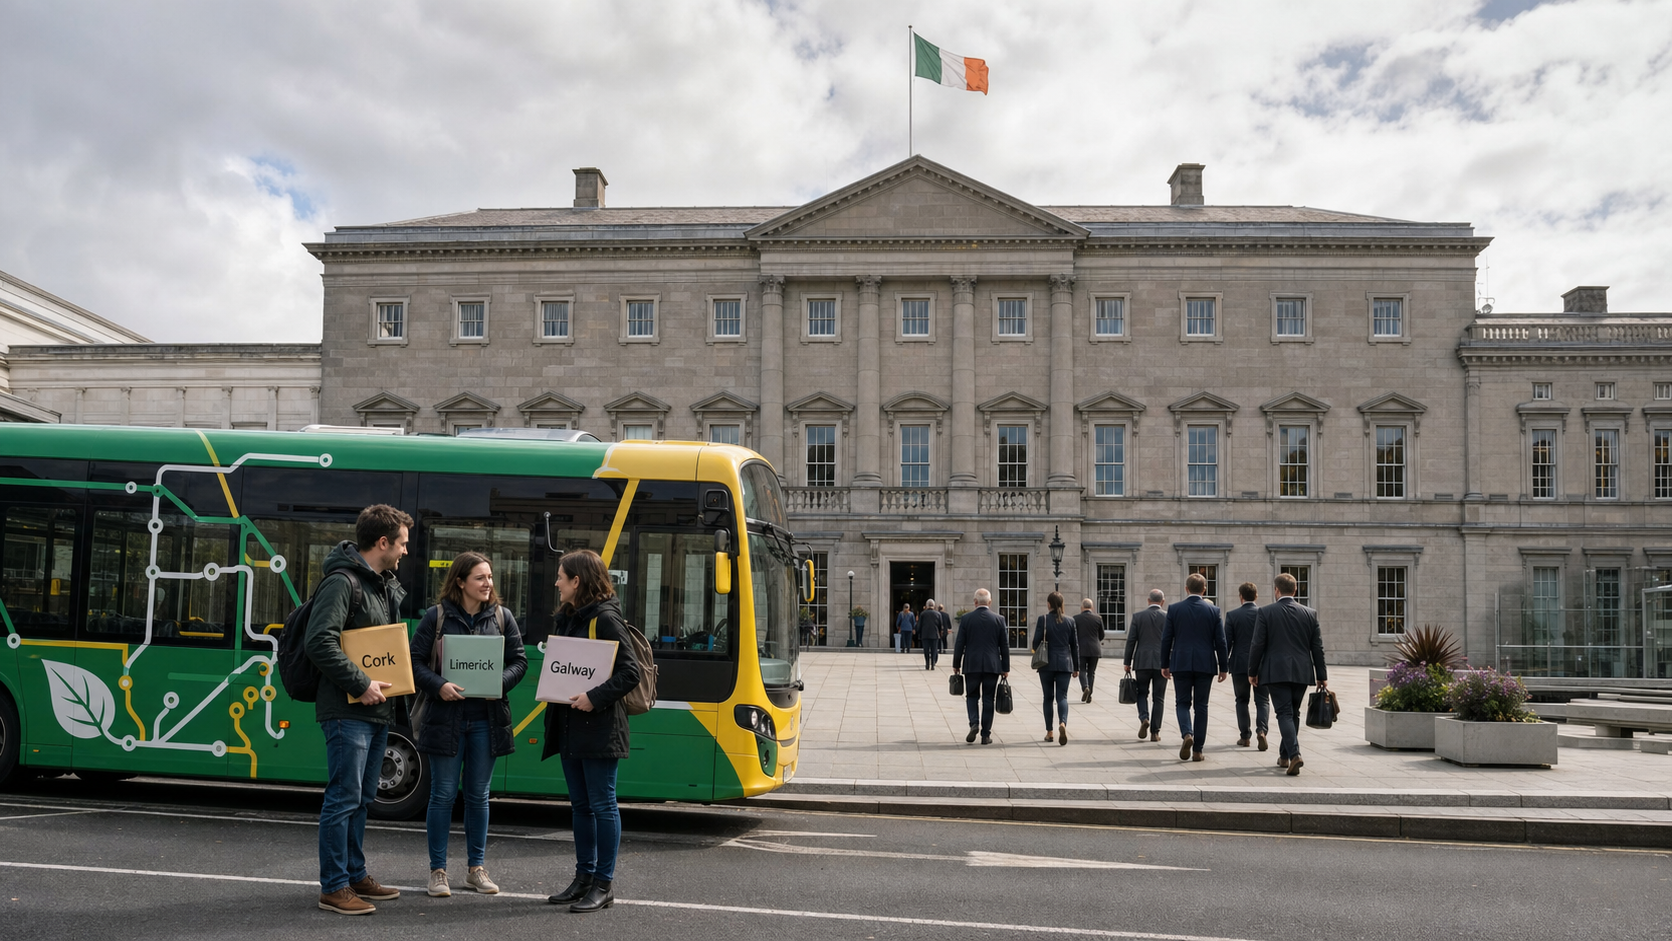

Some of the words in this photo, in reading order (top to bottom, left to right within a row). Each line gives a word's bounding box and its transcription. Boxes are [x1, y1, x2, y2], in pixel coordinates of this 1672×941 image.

[362, 652, 396, 668] Cork
[450, 659, 494, 671] Limerick
[550, 661, 596, 679] Galway
